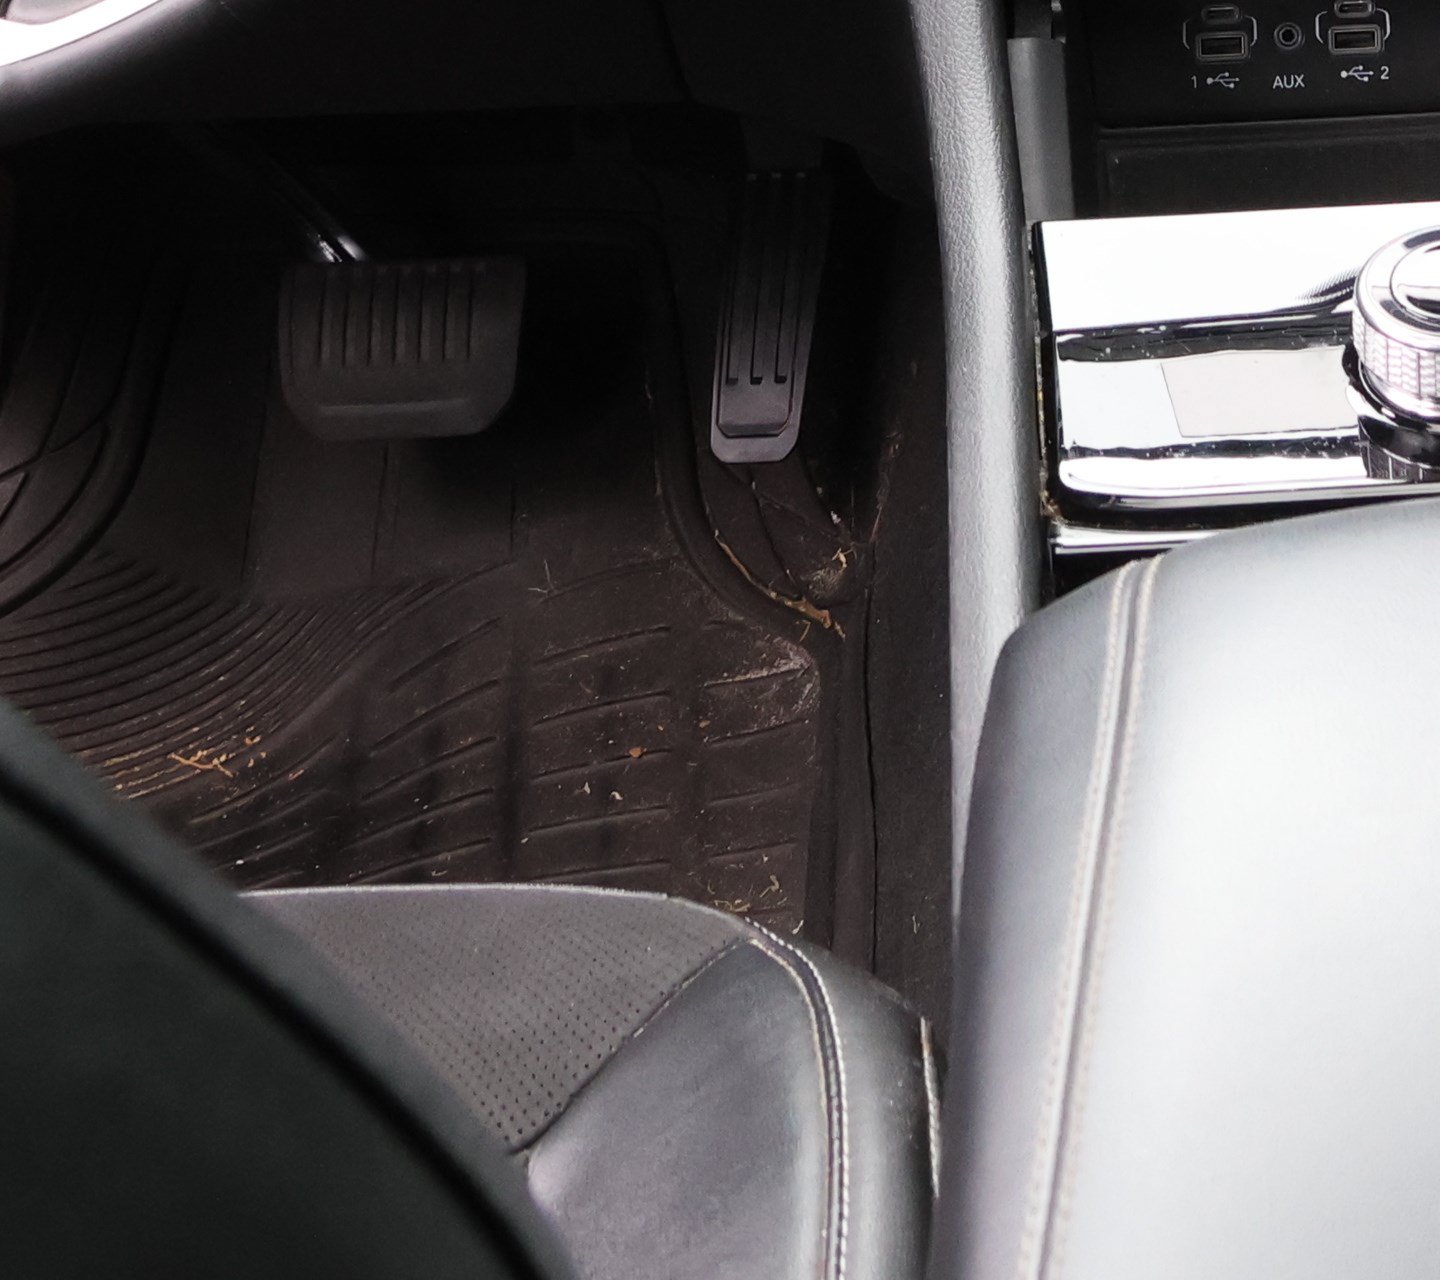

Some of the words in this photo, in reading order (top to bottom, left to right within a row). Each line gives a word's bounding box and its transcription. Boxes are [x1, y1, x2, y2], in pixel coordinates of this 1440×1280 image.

[1380, 65, 1390, 80] 2
[1190, 75, 1198, 89] 1
[1272, 73, 1306, 90] AUX
